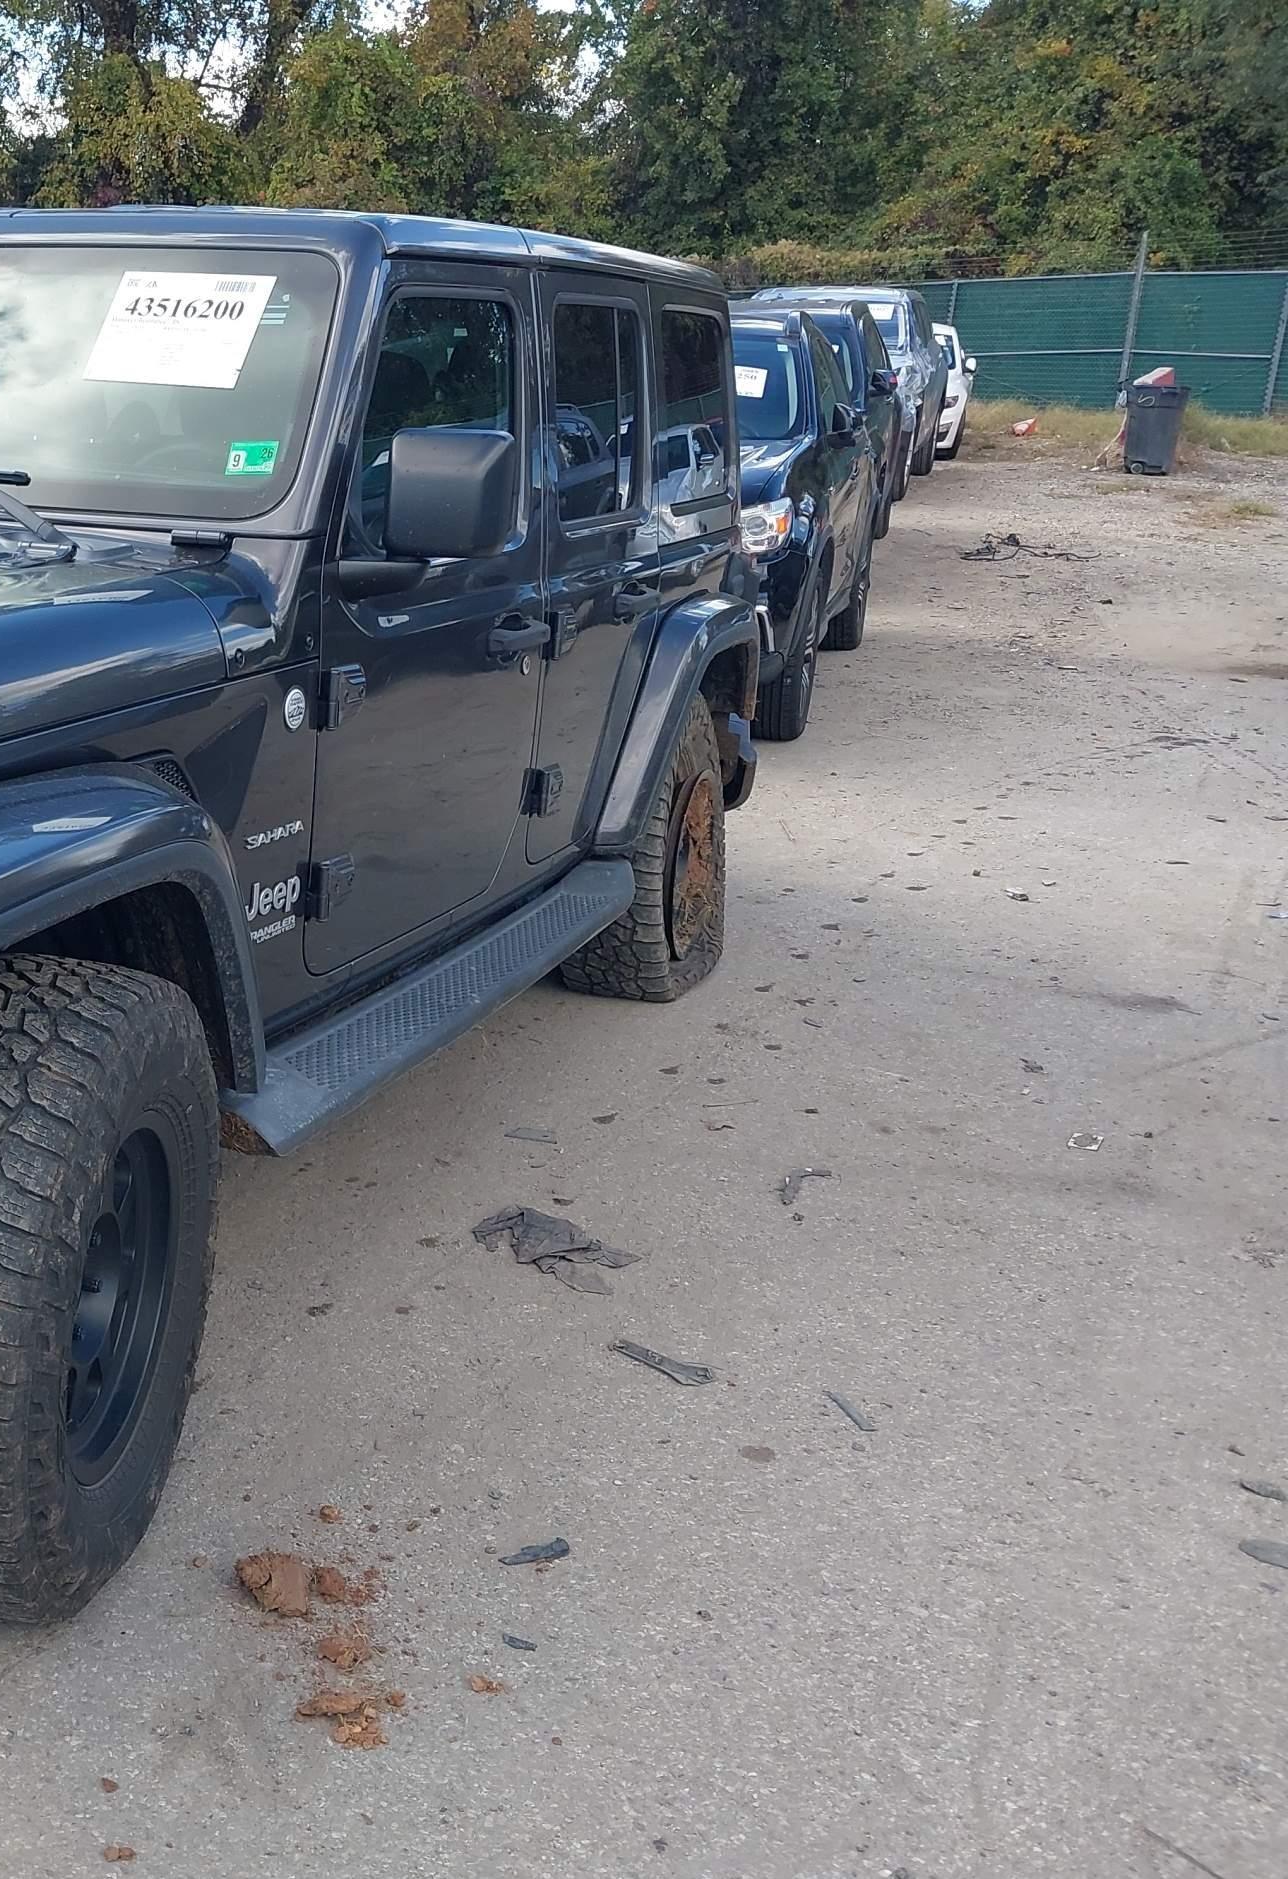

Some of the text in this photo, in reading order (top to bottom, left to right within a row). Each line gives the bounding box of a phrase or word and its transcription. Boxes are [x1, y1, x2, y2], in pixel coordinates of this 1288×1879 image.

[125, 296, 245, 320] 43516200
[232, 453, 241, 467] 9
[260, 447, 274, 459] 26
[245, 820, 304, 849] SAHARA
[245, 875, 300, 921] Jeep
[249, 914, 296, 942] RANGLER
